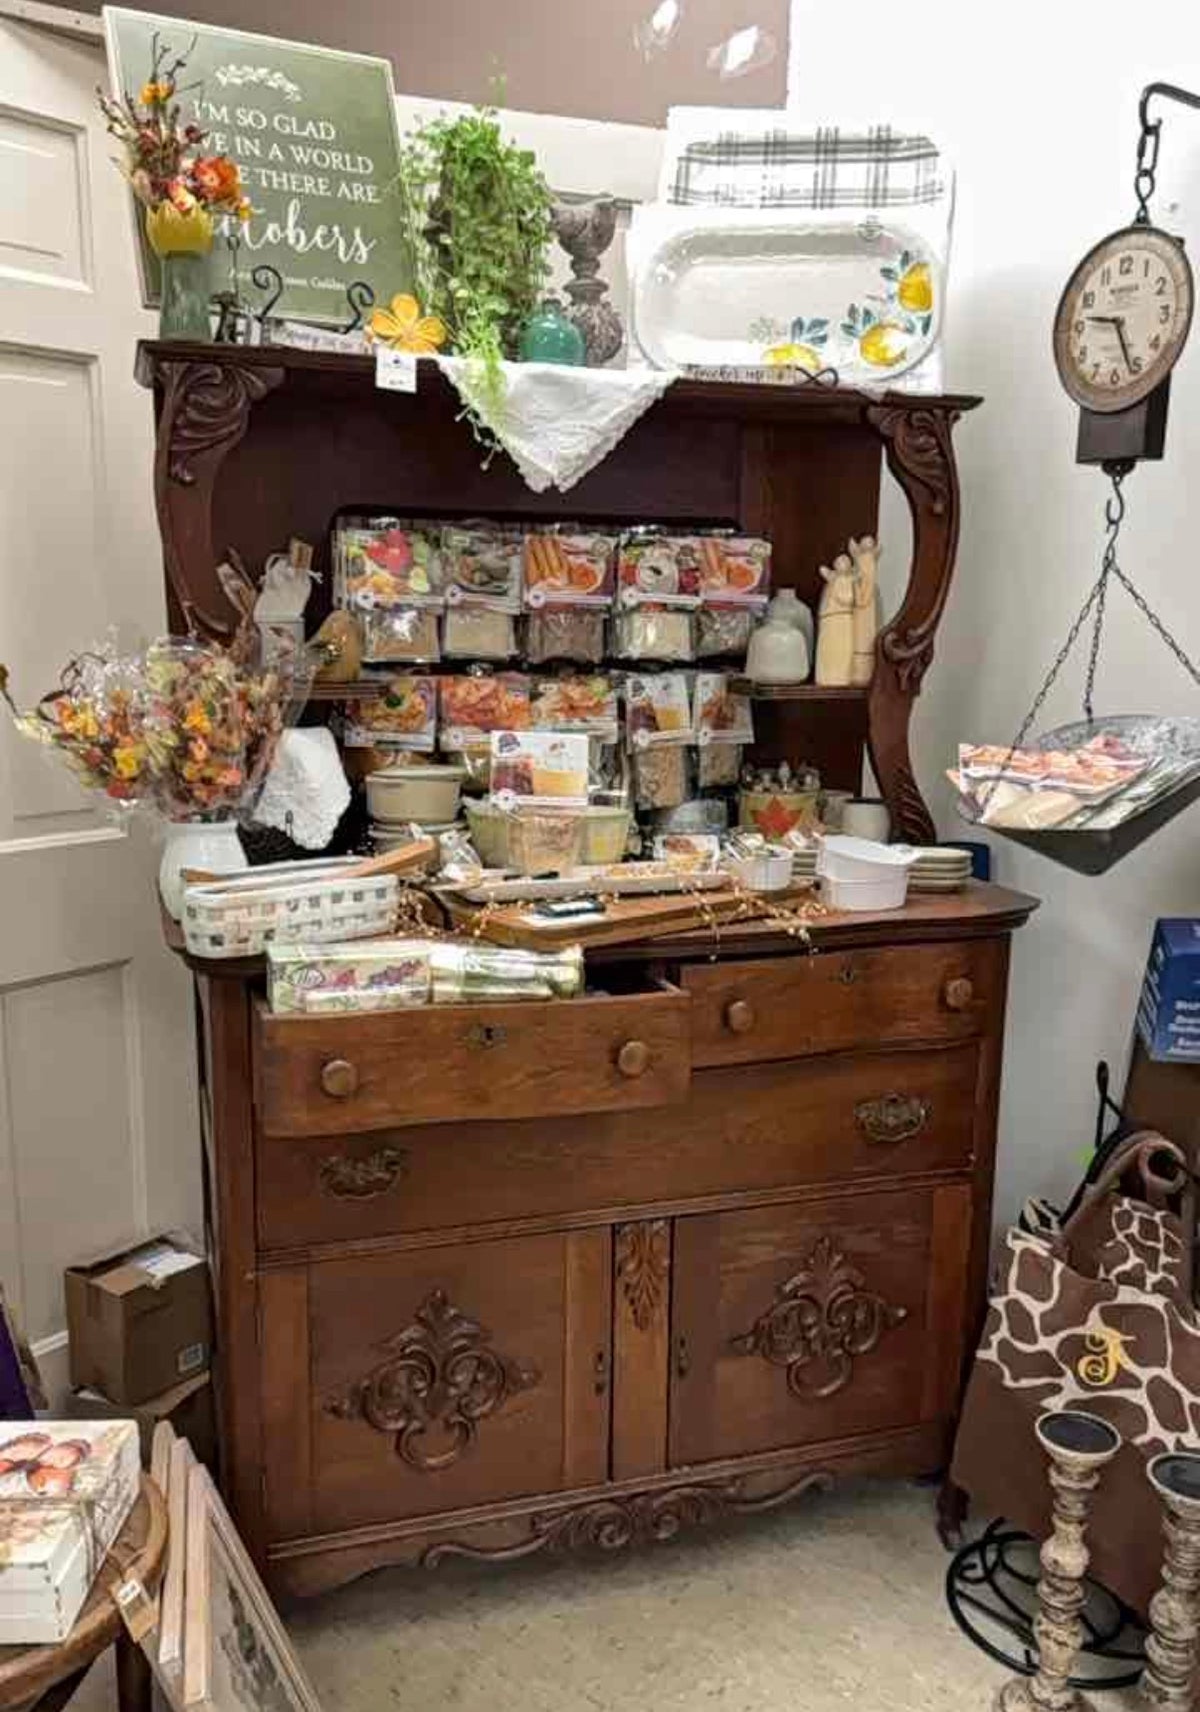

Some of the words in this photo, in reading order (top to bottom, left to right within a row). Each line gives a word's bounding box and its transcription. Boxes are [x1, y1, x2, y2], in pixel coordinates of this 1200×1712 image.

[193, 100, 230, 124] I'M
[236, 107, 267, 129] SO
[273, 114, 336, 140] GLAD
[235, 136, 261, 157] IN
[268, 143, 285, 161] A
[289, 145, 374, 174] WORLD
[254, 168, 332, 196] THERE
[337, 183, 382, 203] ARE
[1119, 255, 1134, 275] 12
[1155, 276, 1167, 296] 2
[1159, 304, 1170, 324] 3
